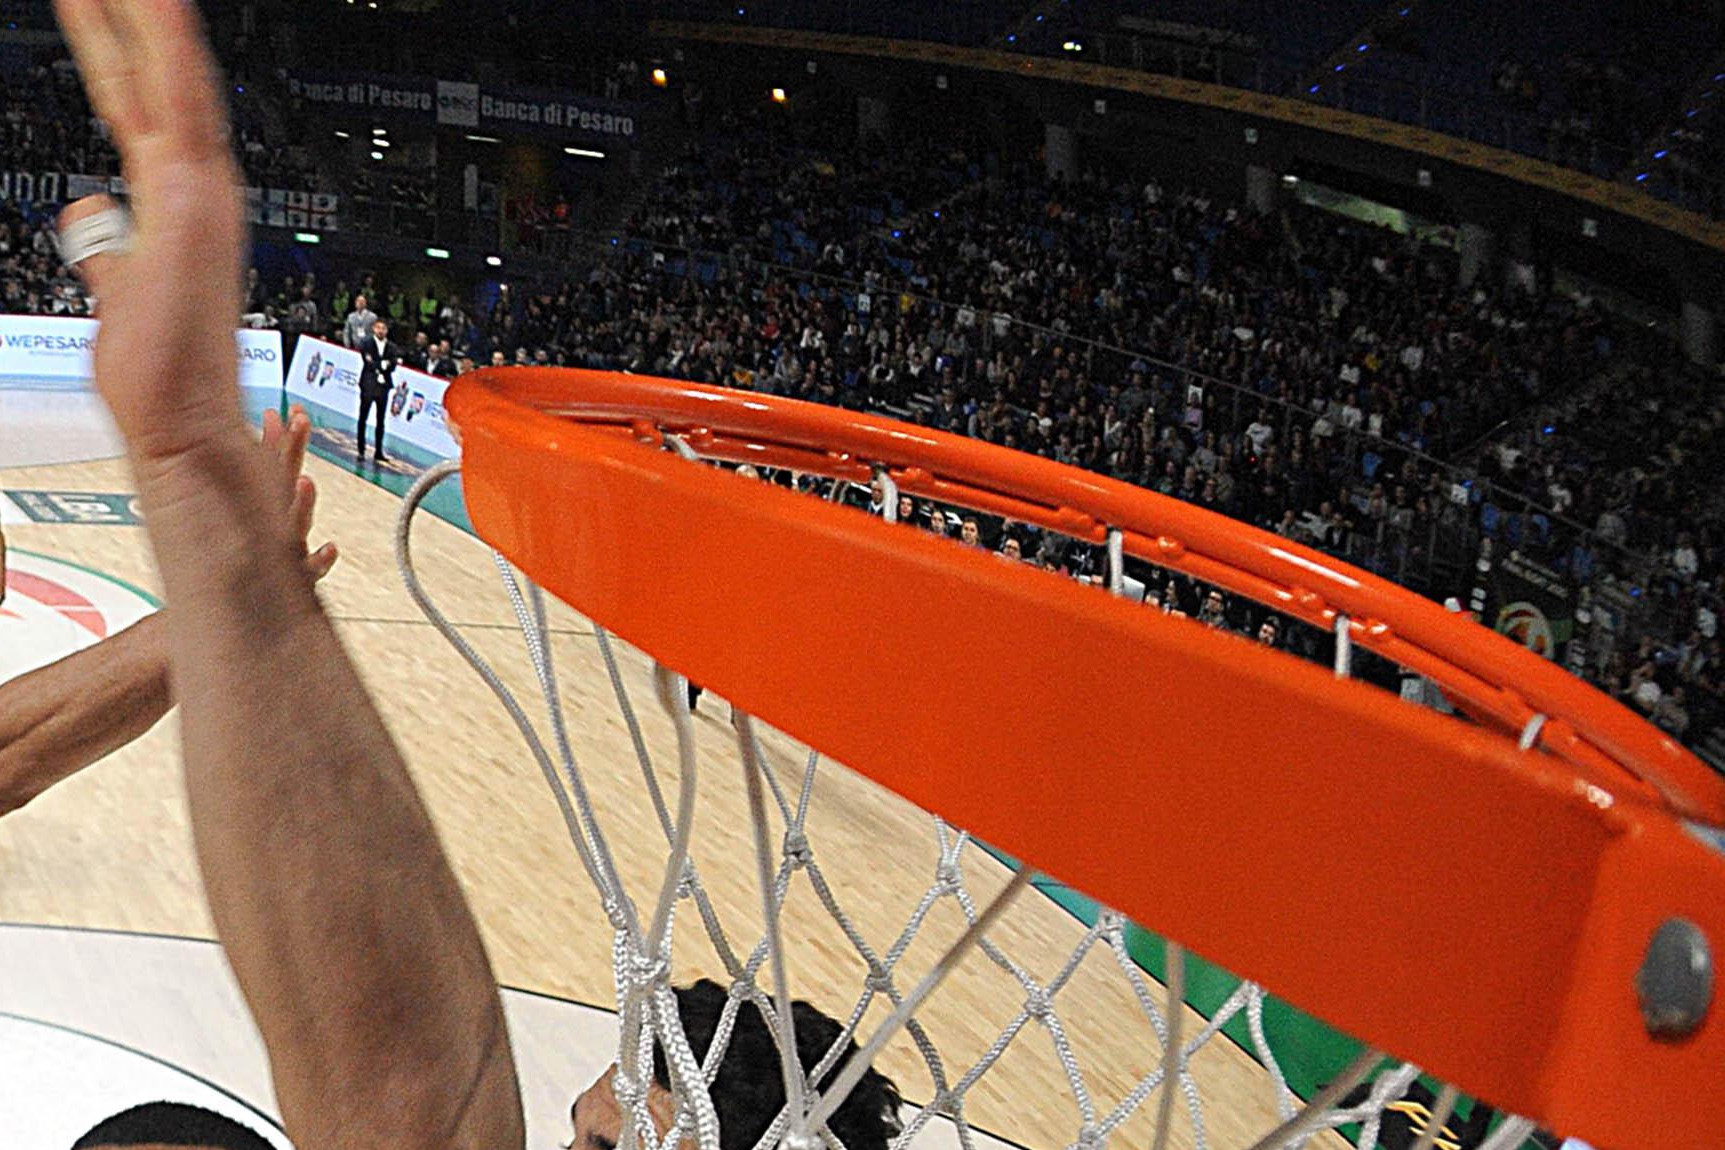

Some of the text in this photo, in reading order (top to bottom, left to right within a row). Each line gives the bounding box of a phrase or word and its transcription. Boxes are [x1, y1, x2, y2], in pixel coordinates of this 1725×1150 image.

[369, 84, 432, 111] Pesaro
[481, 95, 635, 136] Banca di Pesaro
[236, 346, 276, 361] ARO
